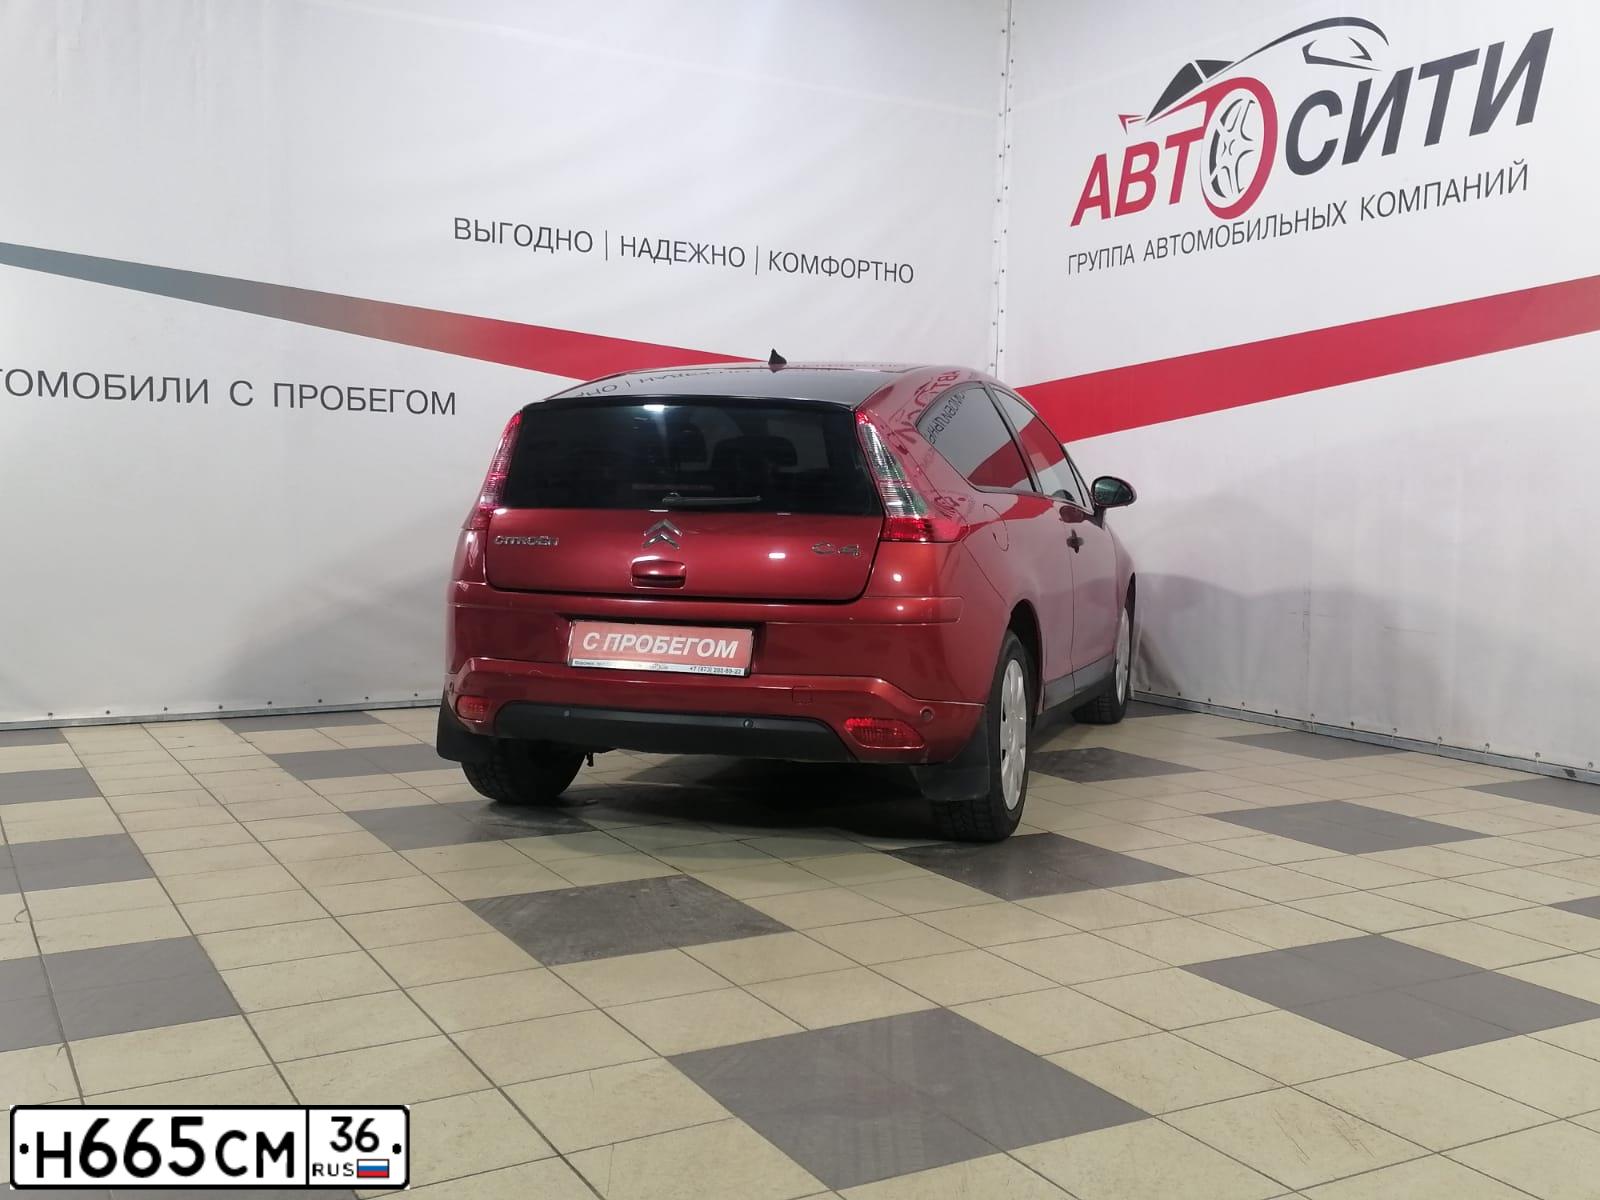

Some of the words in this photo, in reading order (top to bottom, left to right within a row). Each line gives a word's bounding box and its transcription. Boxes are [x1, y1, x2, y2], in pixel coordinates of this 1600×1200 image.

[1068, 243, 1135, 275] ГРУППА
[1143, 200, 1348, 262] АВТОМОБИЛЬНЫХ
[1359, 158, 1529, 222] КОМПАНИЙ
[453, 216, 594, 254] ВЫГОДНО
[619, 235, 746, 268] НАДЕЖНО
[767, 249, 915, 284] КОМФОРТНО
[228, 380, 254, 407] С
[272, 382, 457, 416] ПРОБЕГОМ
[583, 632, 600, 651] С
[603, 633, 739, 659] ПРОБЕГОМ
